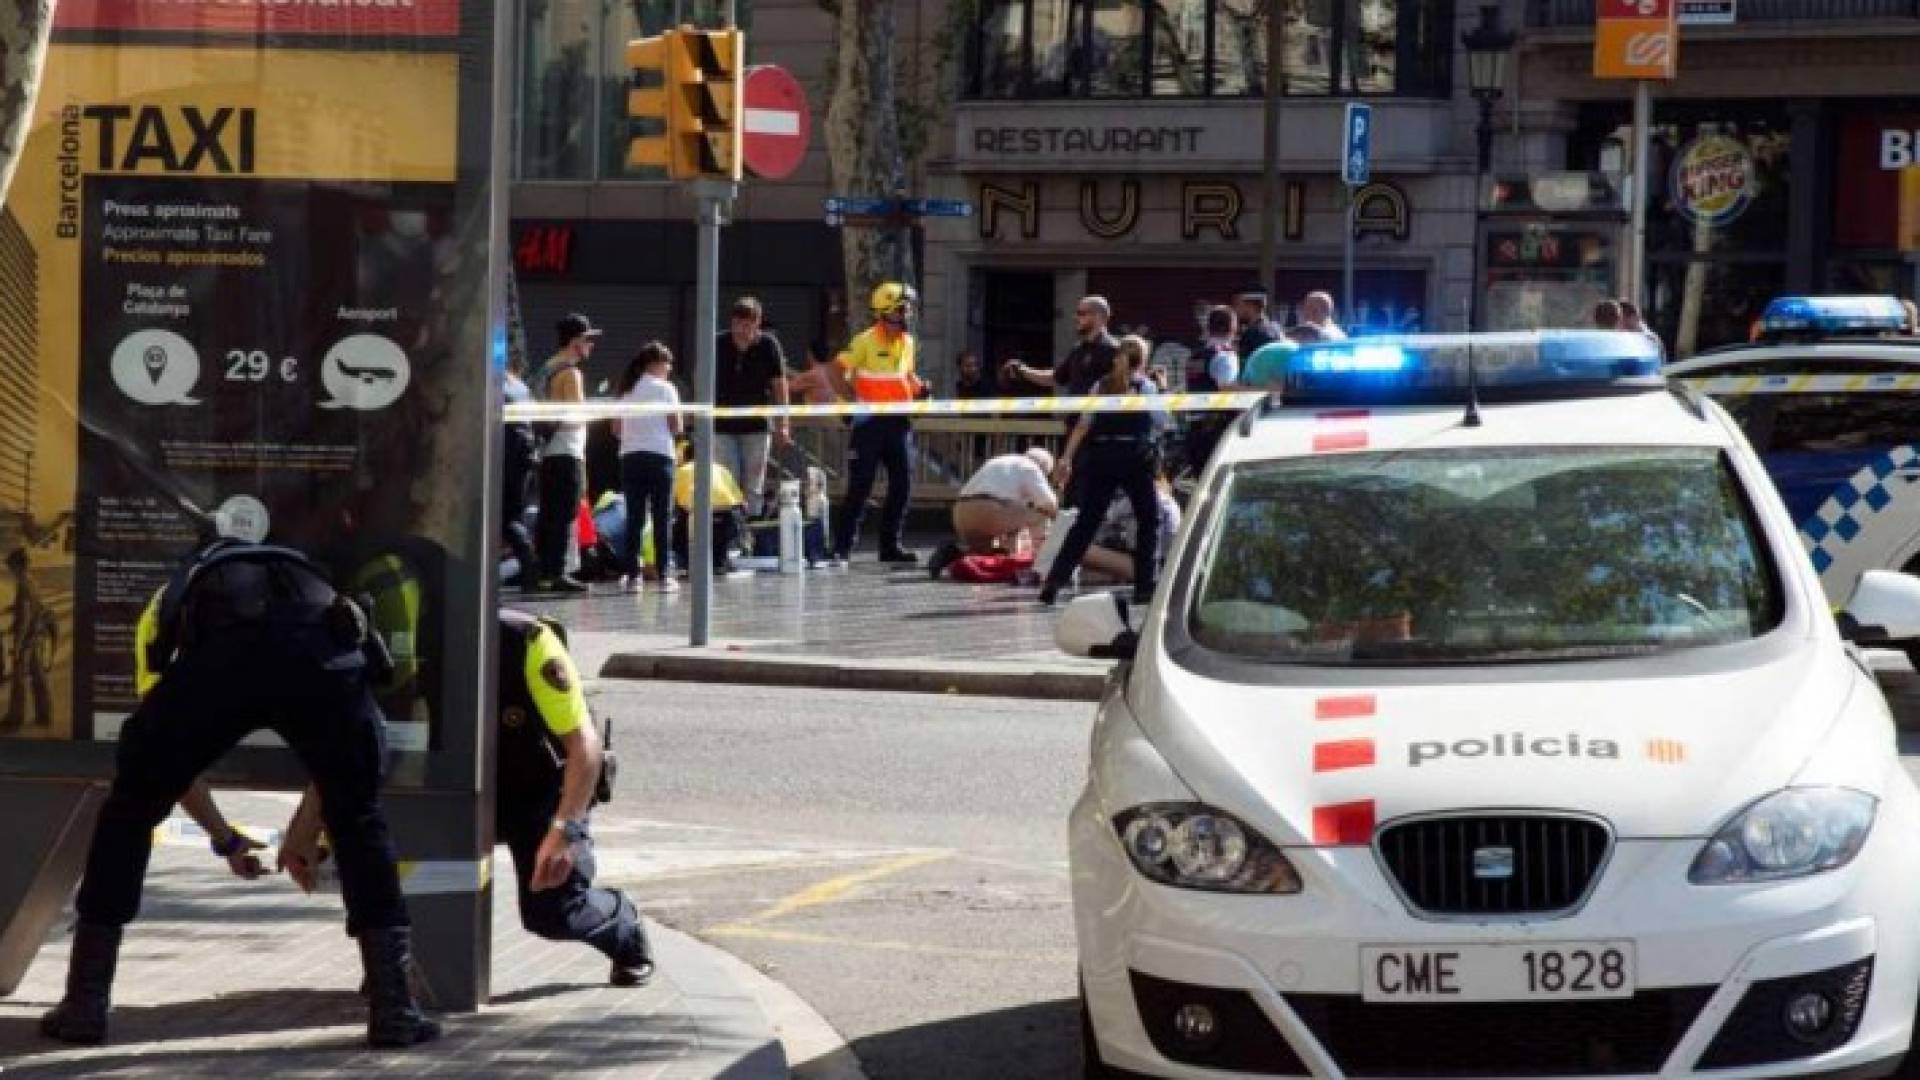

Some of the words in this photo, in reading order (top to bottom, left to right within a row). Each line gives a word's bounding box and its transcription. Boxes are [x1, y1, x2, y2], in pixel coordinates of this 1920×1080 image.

[84, 105, 255, 173] TAXI
[974, 126, 1205, 154] RESTAURANT
[1881, 128, 1920, 171] B
[57, 104, 80, 238] Barcelona
[103, 200, 150, 217] Preus
[153, 202, 240, 220] aproximats
[980, 180, 1412, 241] NURIA
[204, 226, 233, 241] Taxi
[239, 226, 272, 244] Fare
[103, 248, 161, 264] Precios
[169, 284, 187, 298] de
[224, 350, 269, 381] 29
[280, 356, 298, 382] €
[1408, 731, 1621, 766] policia
[1377, 953, 1460, 994] CME
[1521, 949, 1625, 993] 1828
